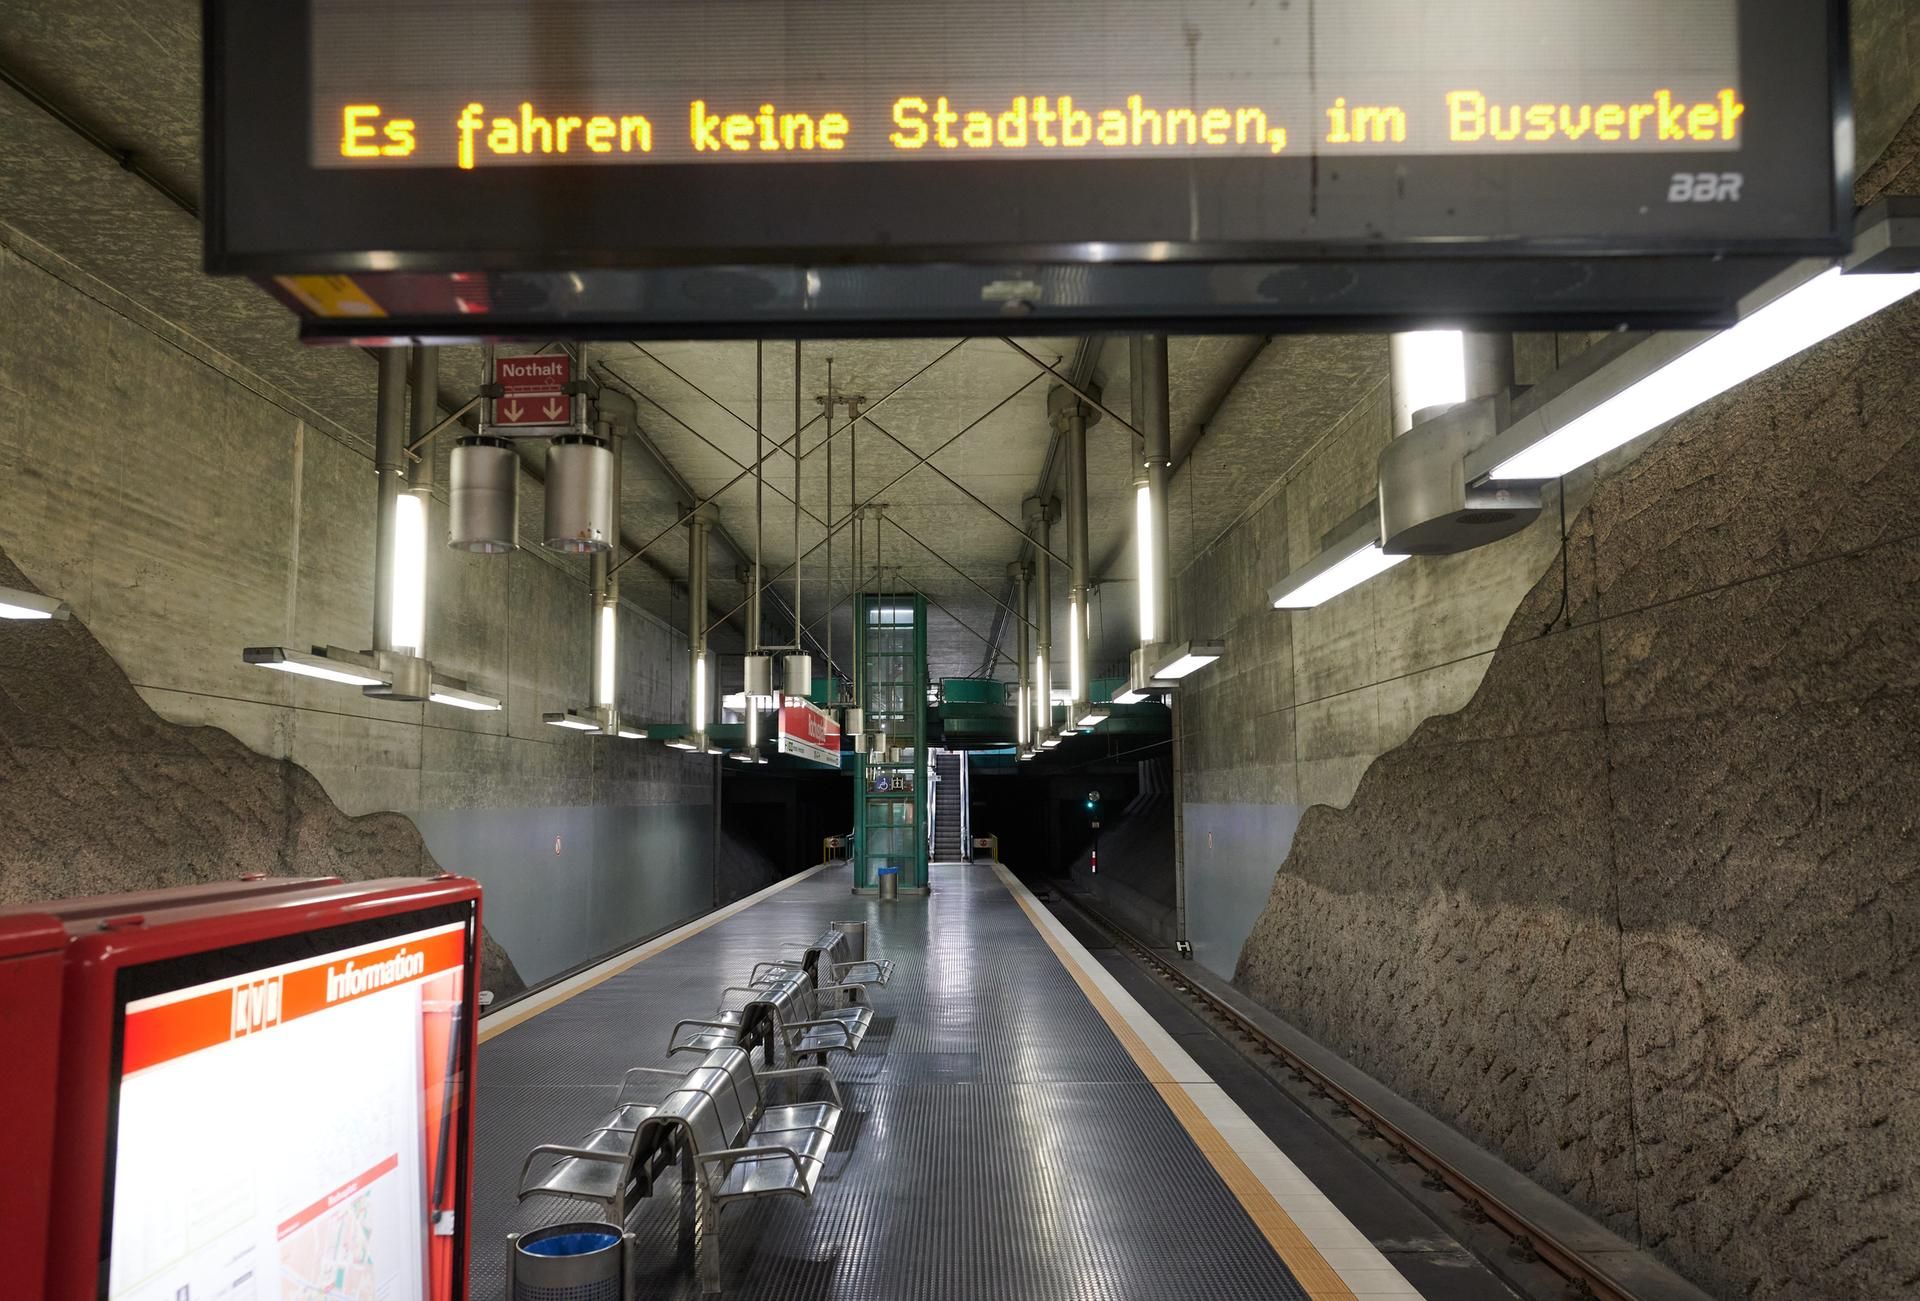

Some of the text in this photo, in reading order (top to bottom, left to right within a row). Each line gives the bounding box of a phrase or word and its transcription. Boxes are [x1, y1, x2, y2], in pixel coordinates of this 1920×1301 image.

[341, 104, 416, 158] Es
[457, 102, 652, 170] fahren
[691, 100, 849, 152] keine
[889, 95, 1287, 153] Stadtbahnen,
[1326, 99, 1406, 143] im
[502, 362, 563, 377] Nothalt
[1176, 941, 1191, 951] H
[326, 947, 425, 1003] Information
